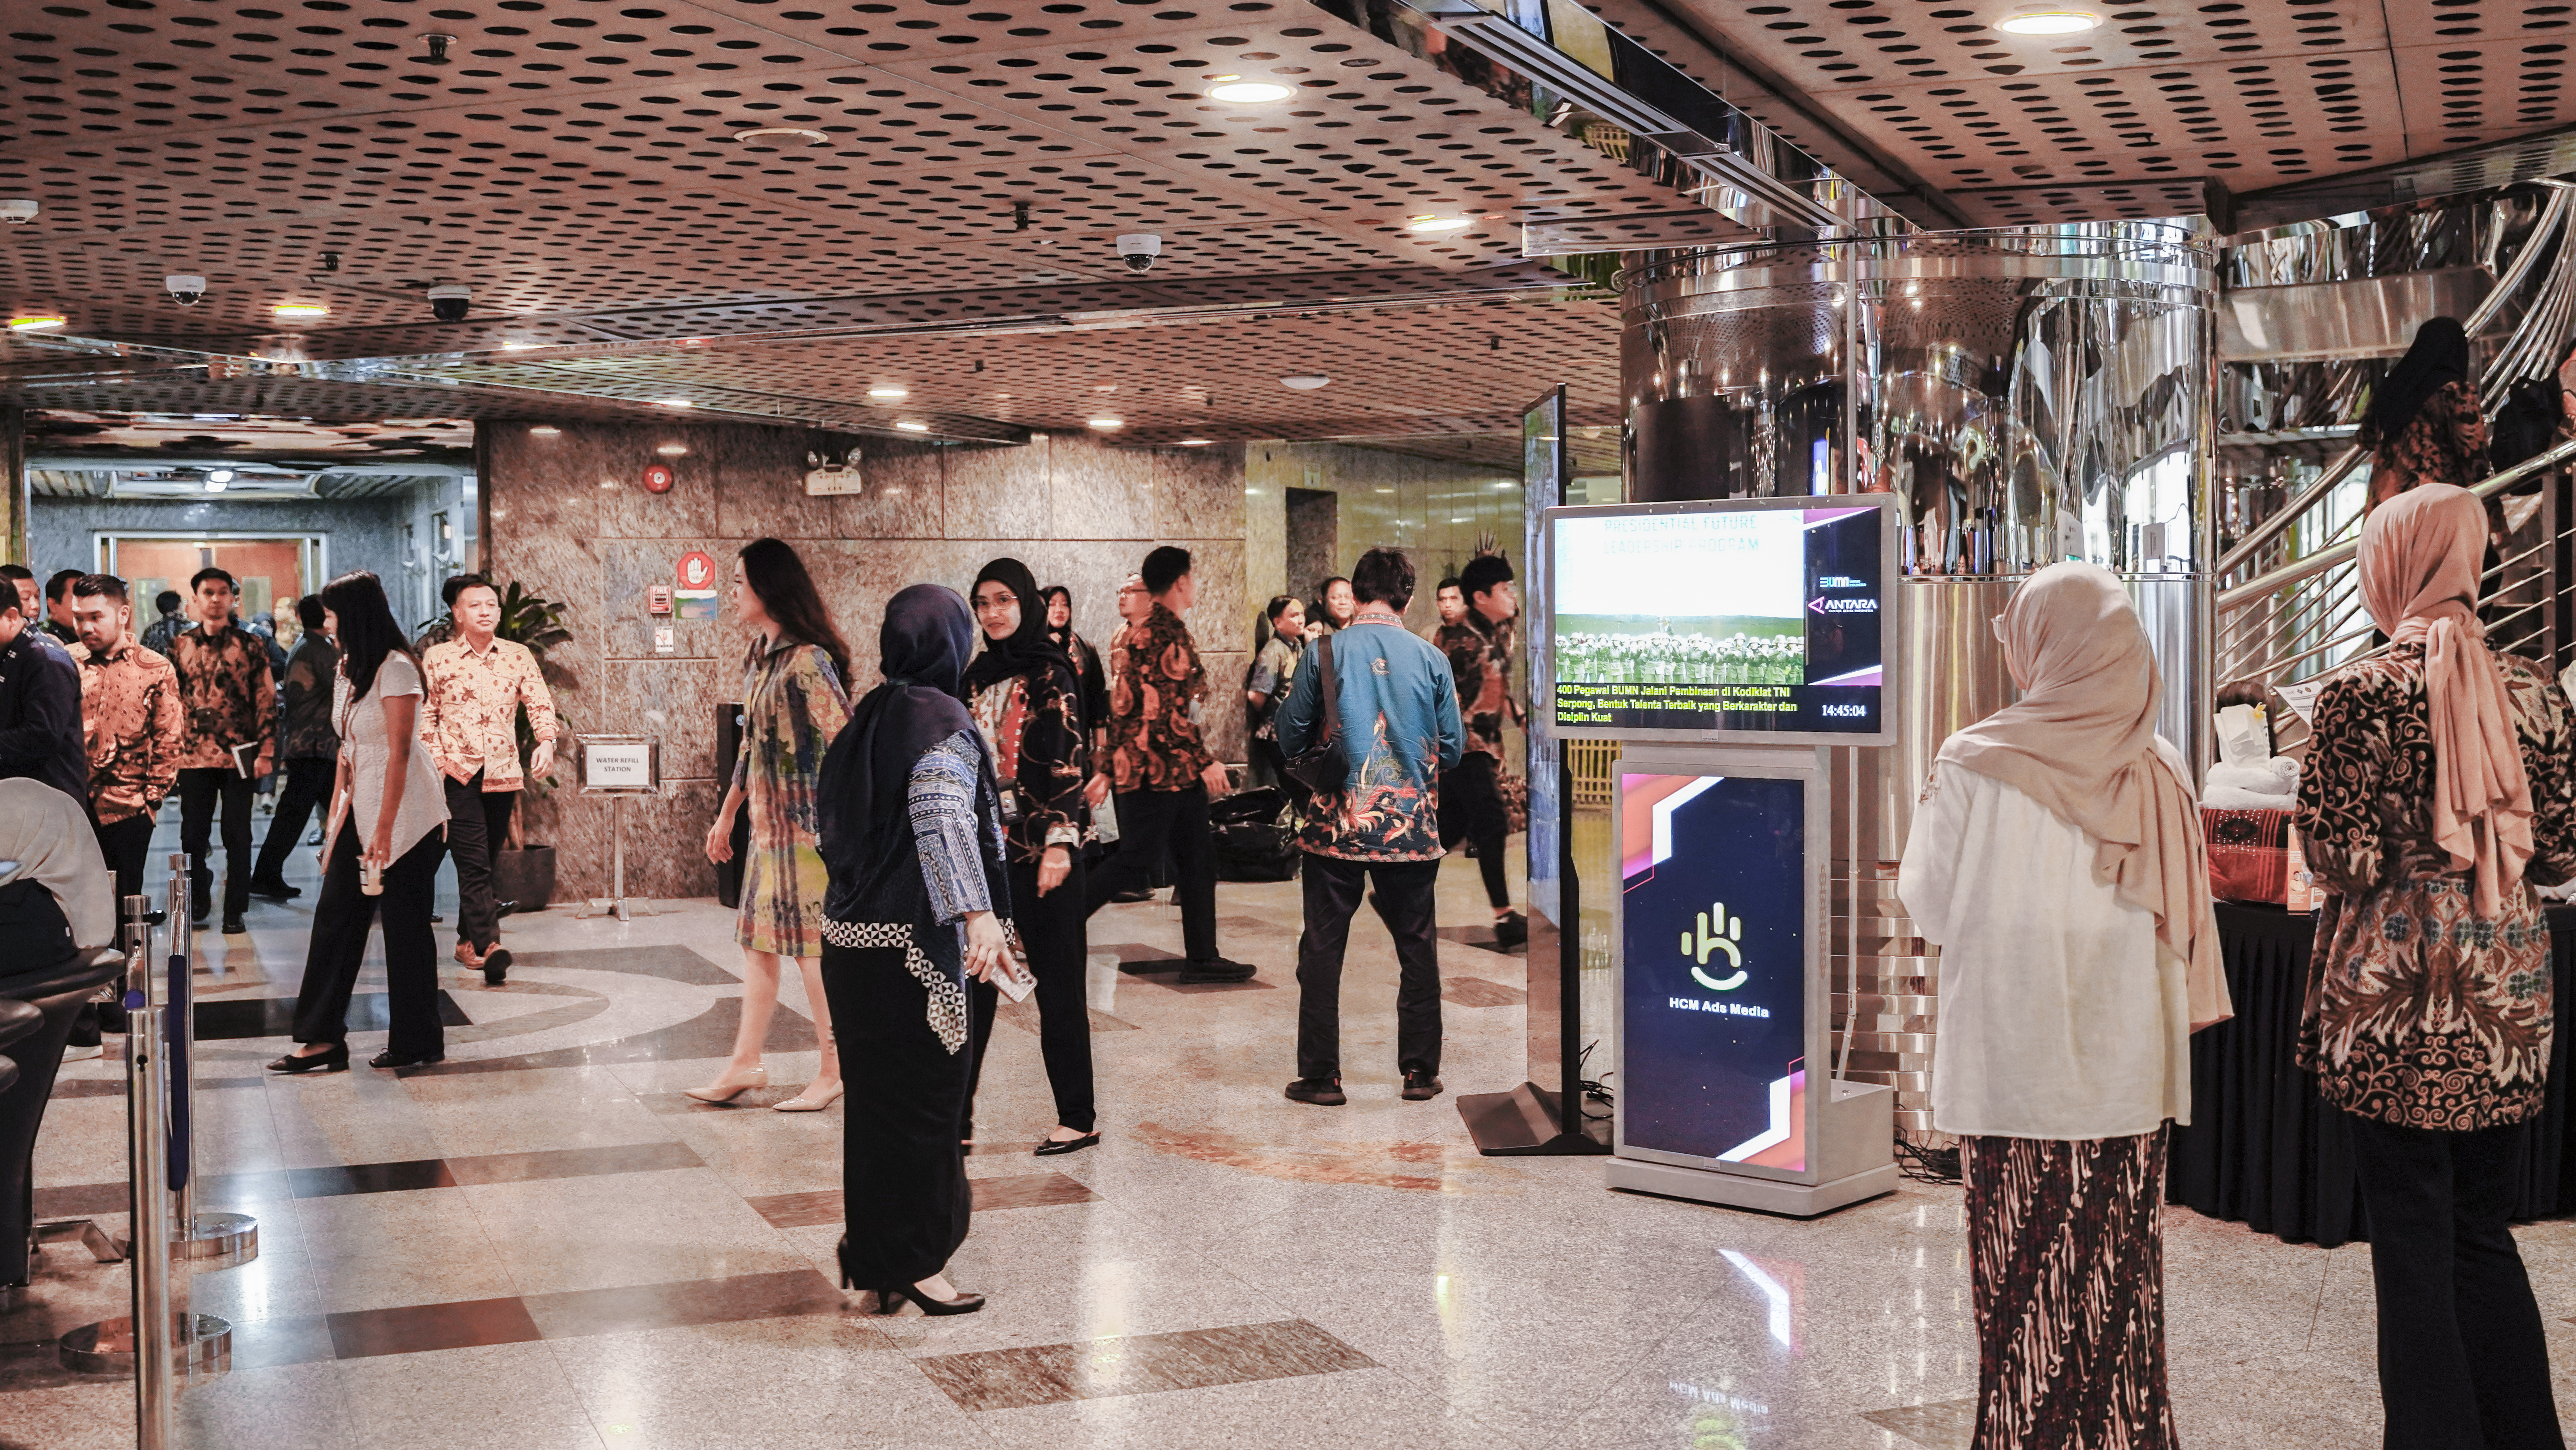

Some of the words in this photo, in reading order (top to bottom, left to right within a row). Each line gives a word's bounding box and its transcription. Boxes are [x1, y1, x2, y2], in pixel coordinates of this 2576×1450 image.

[1704, 515, 1757, 530] FUTURE
[1825, 599, 1878, 610] ANTARA
[1556, 685, 1572, 694] 400
[1574, 685, 1610, 696] Pegawai
[1611, 685, 1639, 695] BUMN
[1641, 686, 1667, 695] Jalani
[1669, 686, 1719, 696] Pembinaan
[1722, 687, 1730, 696] di
[1733, 687, 1772, 697] Kodiklat
[1773, 687, 1790, 697] TNI
[1557, 698, 1596, 710] Serpong,
[1598, 699, 1628, 709] Bentuk
[1629, 699, 1662, 709] Talenta
[1663, 699, 1696, 710] Terbaik
[1698, 702, 1721, 712] yang
[1723, 700, 1777, 711] Berkarakter
[1778, 701, 1798, 712] dan
[1822, 704, 1866, 716] 14:45:04
[1557, 712, 1589, 723] Disiplin
[1591, 712, 1612, 722] Kuat
[1669, 997, 1700, 1011] HCM
[1701, 1001, 1727, 1013] Ads
[1730, 1003, 1770, 1018] Media
